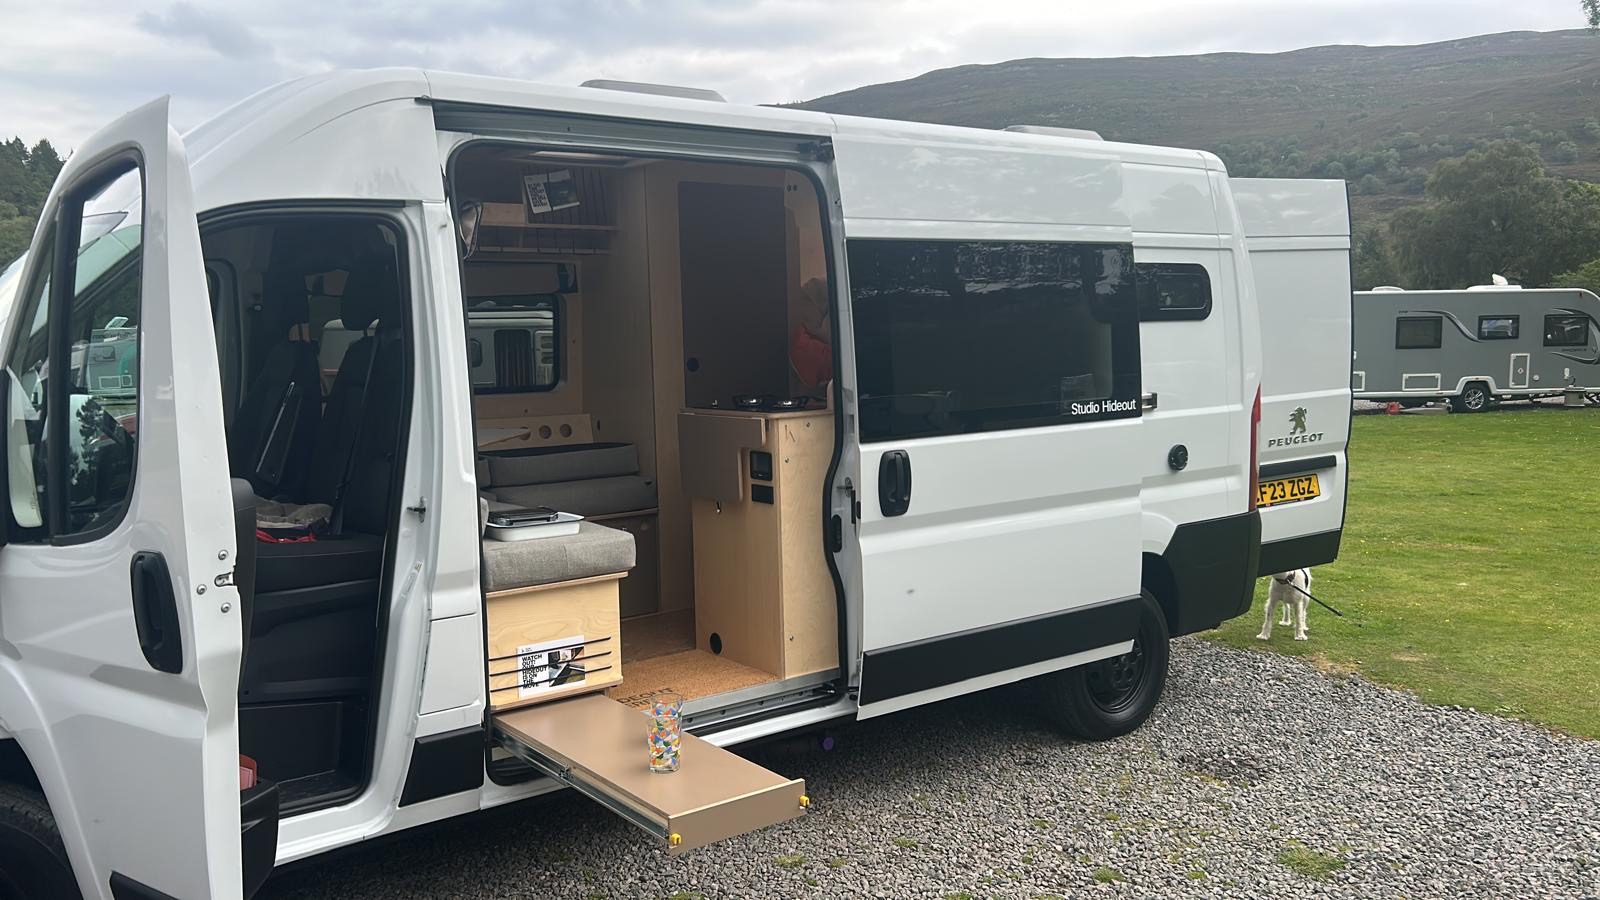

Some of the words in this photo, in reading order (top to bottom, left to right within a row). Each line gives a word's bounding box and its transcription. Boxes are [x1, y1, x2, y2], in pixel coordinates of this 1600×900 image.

[1071, 402, 1100, 415] Studio
[1102, 399, 1136, 412] Hideout
[1268, 433, 1324, 447] PEUGEOT
[1256, 481, 1286, 502] F23
[1288, 477, 1315, 497] ZGZ
[522, 653, 543, 662] WATCH
[522, 666, 548, 676] HIDEOUT
